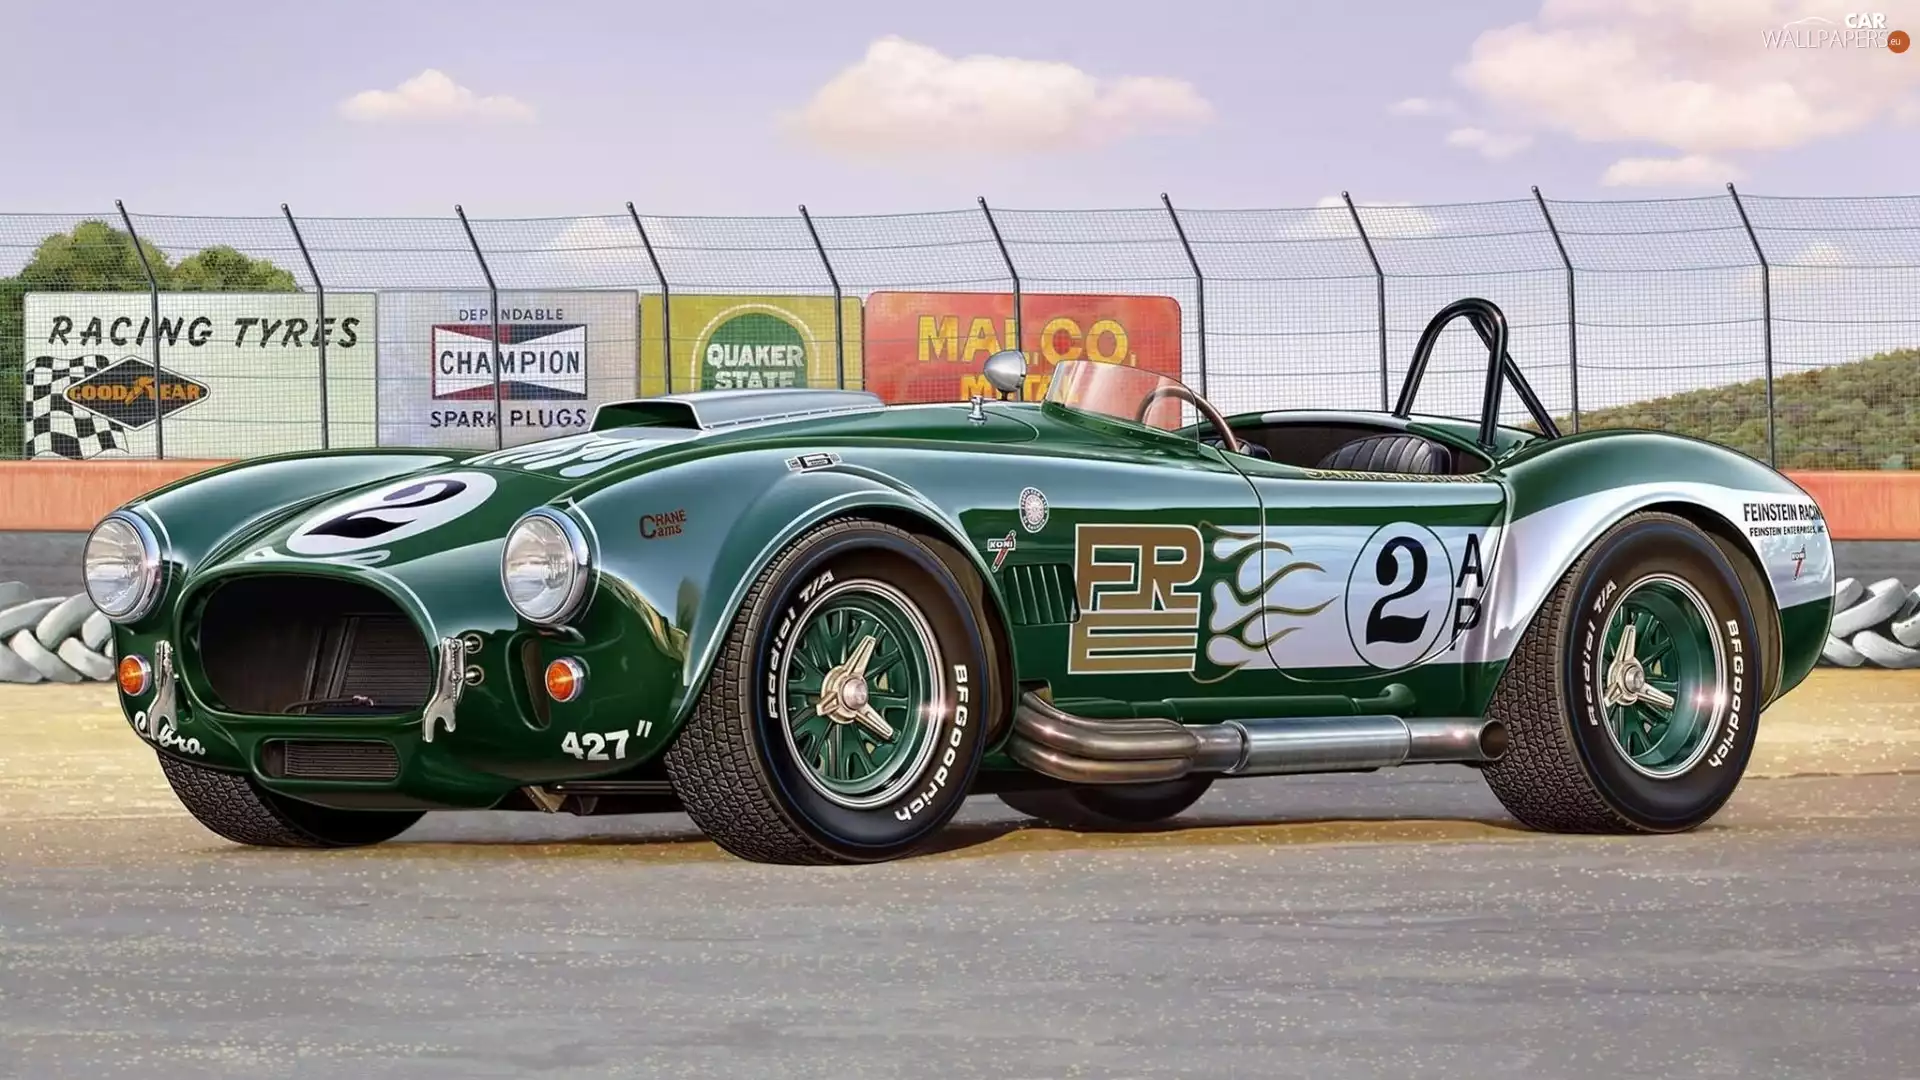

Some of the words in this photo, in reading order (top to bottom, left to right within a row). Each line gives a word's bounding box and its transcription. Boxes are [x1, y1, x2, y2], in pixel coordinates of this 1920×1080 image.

[459, 308, 564, 321] DEPNDABLE
[48, 315, 213, 347] RACING
[234, 317, 360, 349] TYRES
[440, 350, 580, 375] CHAMPION
[706, 343, 805, 369] QUAKER
[714, 370, 796, 389] STATE
[430, 410, 497, 428] SPARK
[510, 408, 587, 429] PLUGS
[302, 479, 468, 539] 2
[1743, 503, 1798, 521] FEINSTEIN
[1749, 526, 1782, 537] FEINSTEIN
[989, 540, 1014, 549] KONI
[1366, 536, 1430, 645] 2
[1708, 619, 1744, 768] BFGoodrich
[894, 664, 969, 821] BFGoodrich
